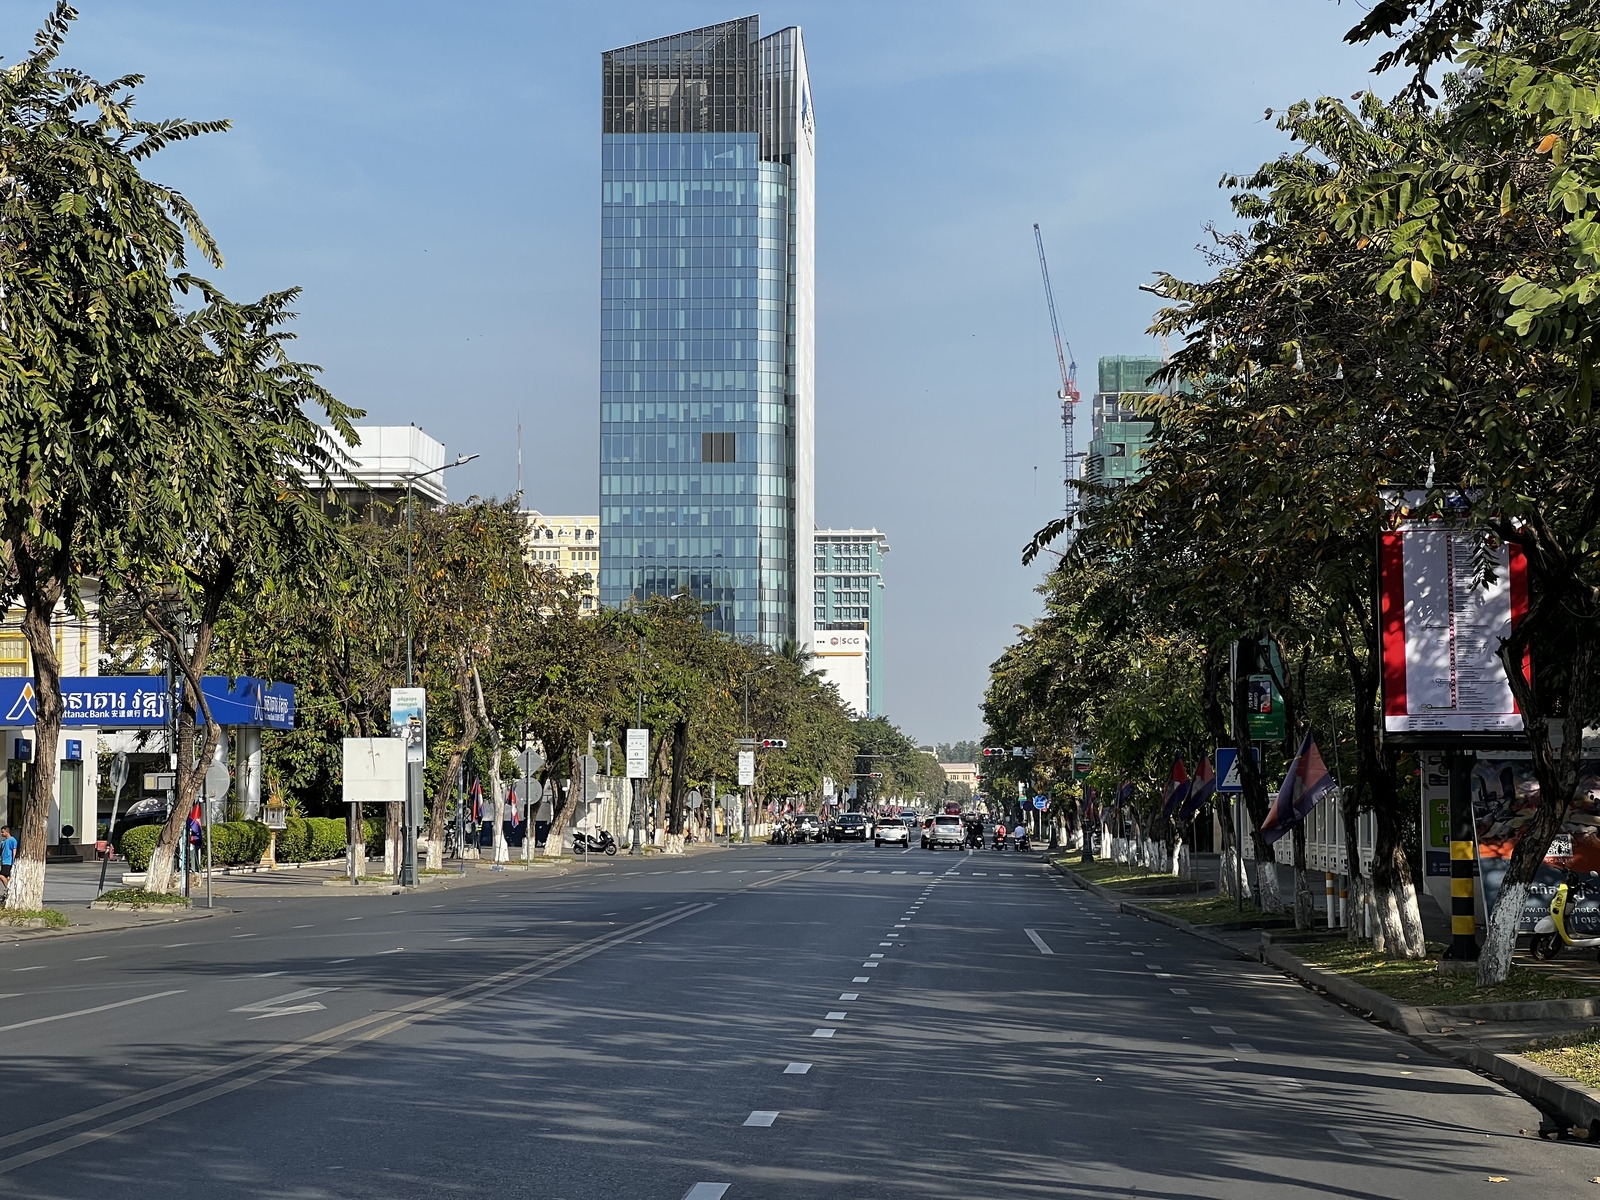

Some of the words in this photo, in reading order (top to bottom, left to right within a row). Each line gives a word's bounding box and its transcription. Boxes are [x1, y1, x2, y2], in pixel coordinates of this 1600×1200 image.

[62, 710, 89, 718] ttanac
[90, 710, 110, 718] Bank
[111, 709, 141, 718] 安達銀行
